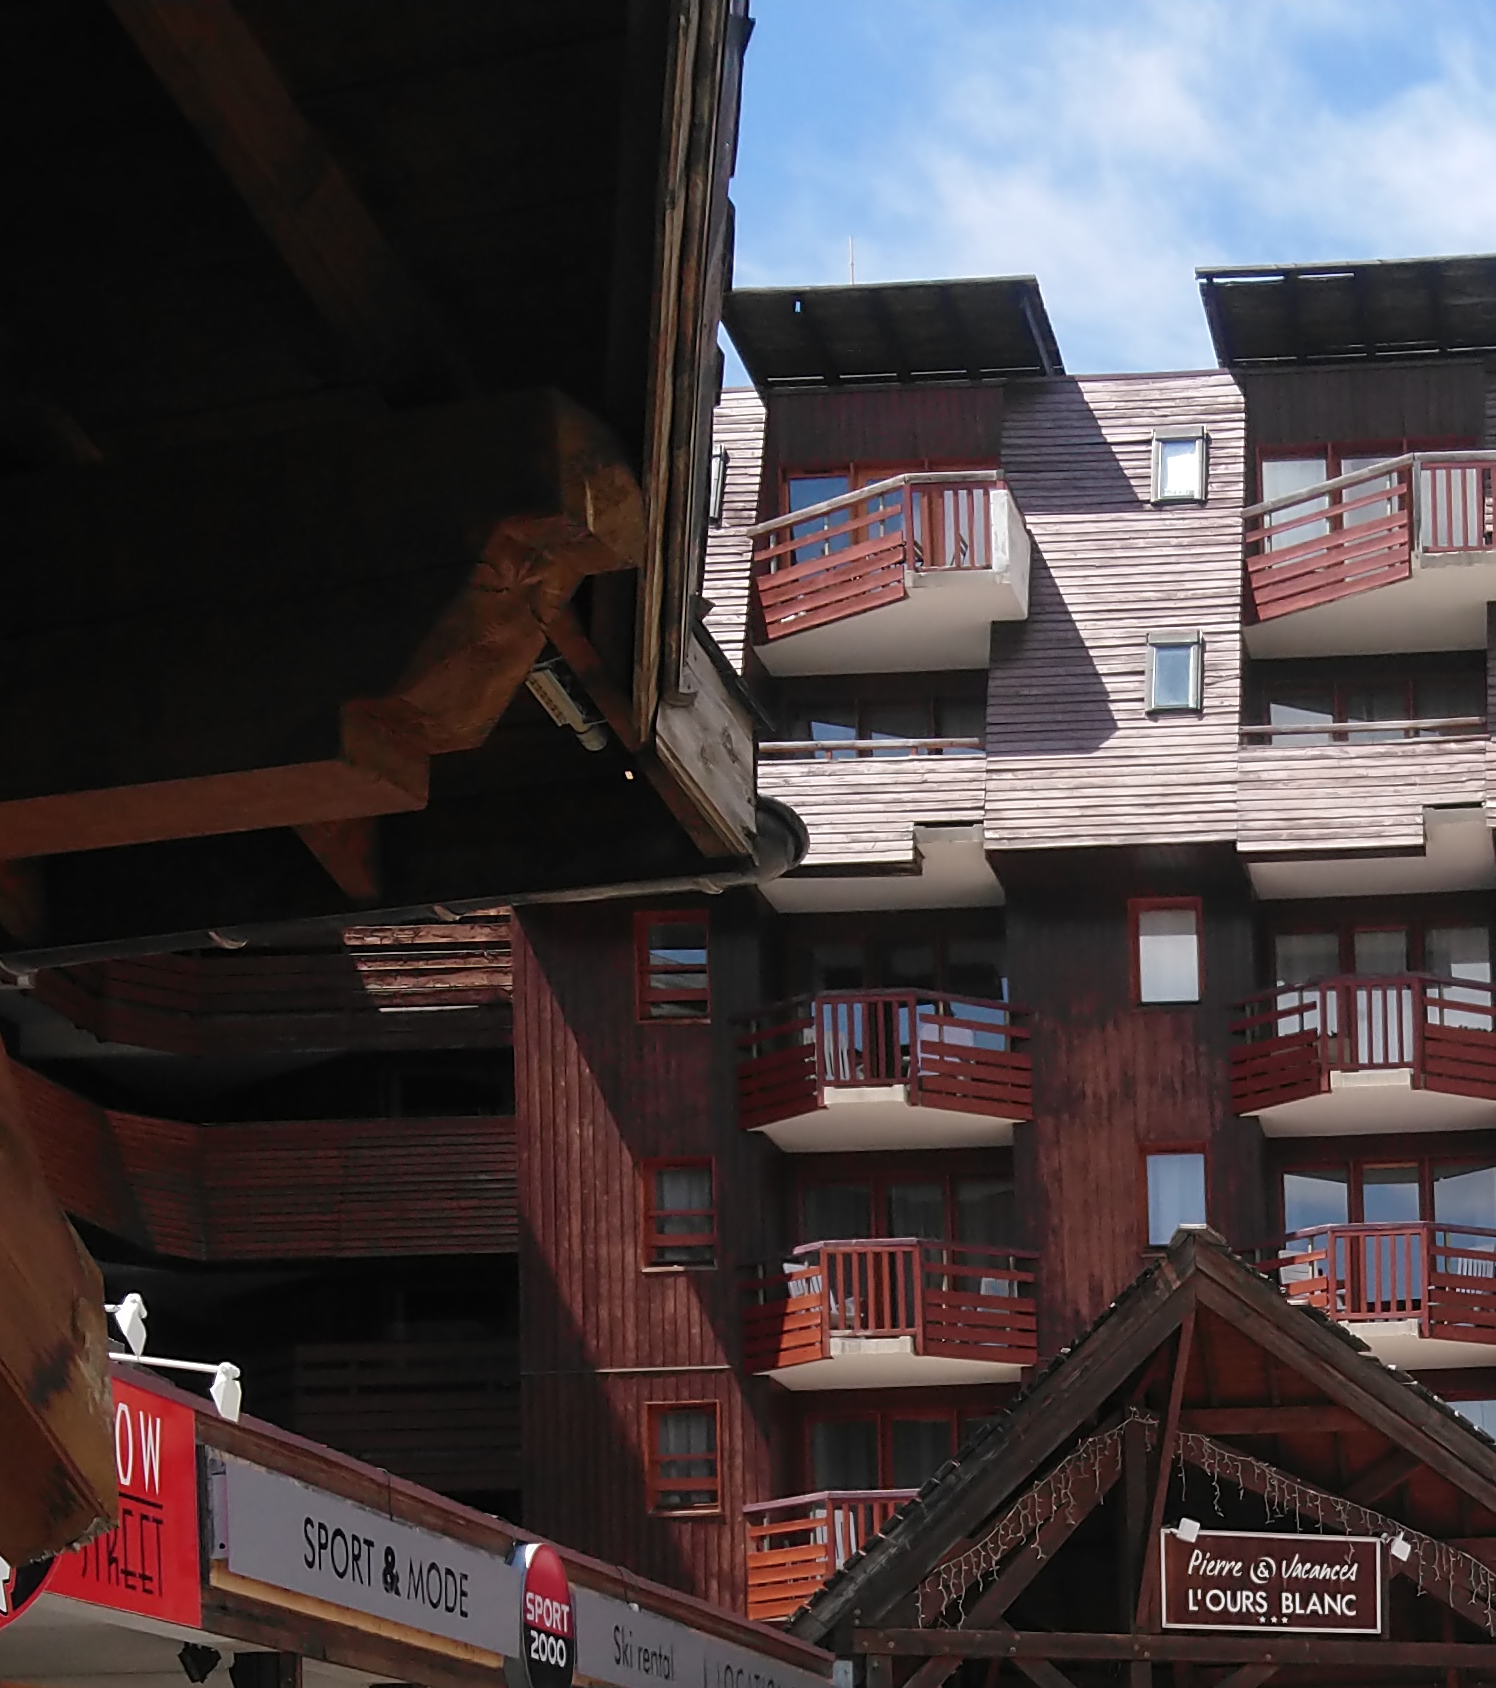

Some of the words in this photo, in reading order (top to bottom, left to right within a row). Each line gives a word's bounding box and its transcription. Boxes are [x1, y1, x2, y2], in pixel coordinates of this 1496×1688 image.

[303, 1516, 375, 1588] SPORT
[382, 1546, 401, 1598] &
[407, 1557, 469, 1618] MODE
[1188, 1549, 1243, 1577] Pierre
[1281, 1553, 1358, 1582] Vacances
[525, 1592, 570, 1633] SPORT
[1188, 1588, 1268, 1614] L'OURS
[1282, 1592, 1357, 1616] BLANC
[530, 1629, 567, 1668] 2000
[613, 1625, 634, 1668] Ski
[637, 1644, 675, 1682] rental
